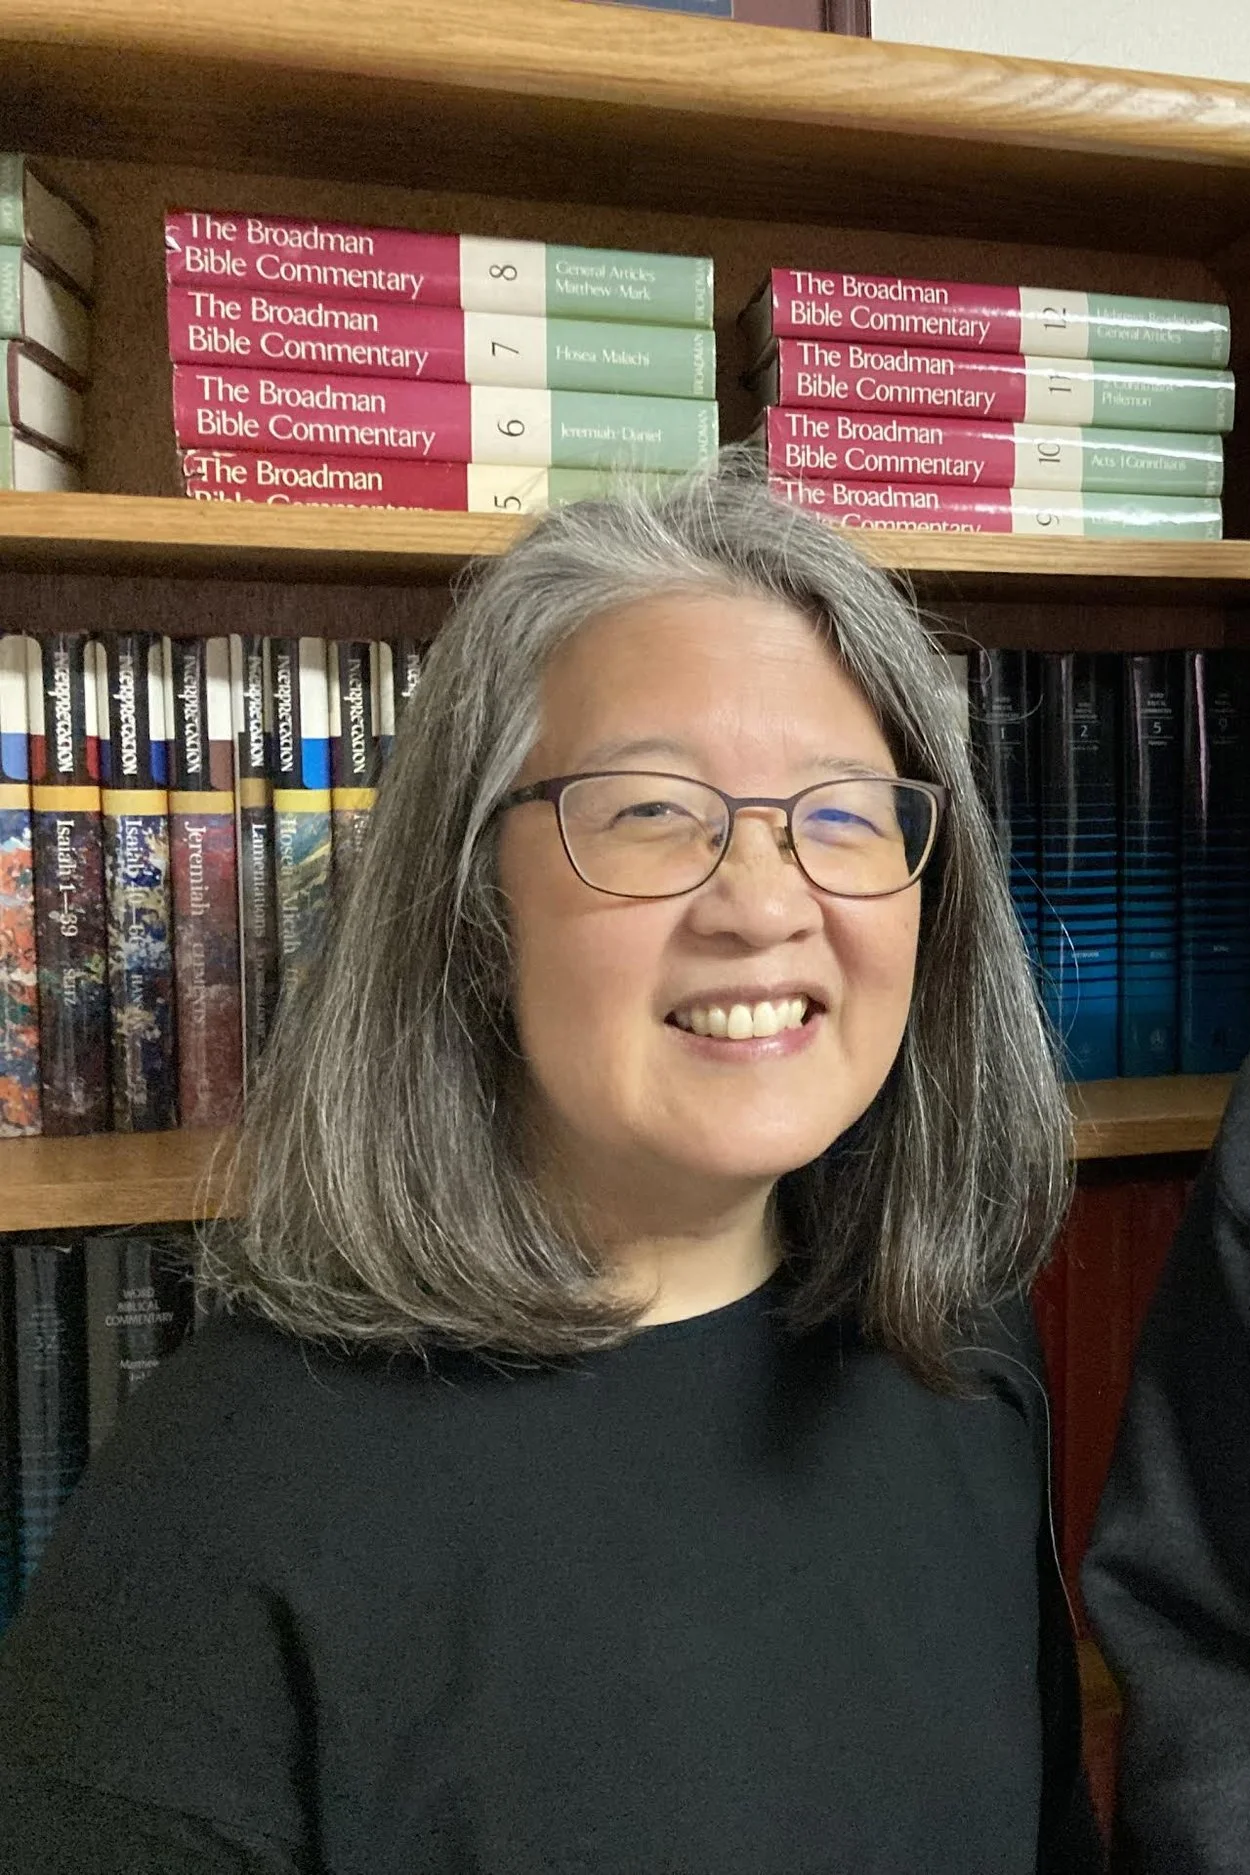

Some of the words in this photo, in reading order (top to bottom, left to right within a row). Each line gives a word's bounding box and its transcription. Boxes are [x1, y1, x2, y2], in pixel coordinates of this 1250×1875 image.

[185, 213, 237, 241] The
[247, 218, 374, 256] Broadman
[185, 246, 248, 276] Bible
[256, 254, 424, 299] Commentary
[489, 263, 518, 282] 8
[790, 270, 835, 296] The
[842, 275, 948, 305] Broadman
[188, 291, 241, 320] The
[251, 296, 379, 332] Broadman
[790, 299, 843, 327] Bible
[849, 305, 991, 344] Commentary
[188, 325, 251, 355] Bible
[260, 332, 429, 375] Commentary
[491, 341, 520, 357] 7
[797, 343, 842, 368] The
[849, 346, 954, 376] Broadman
[196, 375, 250, 404] The
[259, 379, 386, 413] Broadman
[797, 373, 849, 399] Bible
[856, 377, 996, 414] Commentary
[197, 408, 260, 438] Bible
[269, 414, 436, 455] Commentary
[497, 418, 525, 437] 6
[785, 413, 830, 439] The
[837, 416, 943, 445] Broadman
[196, 456, 248, 484] The
[257, 460, 383, 491] Broadman
[785, 443, 838, 470] Bible
[845, 448, 985, 483] Commentary
[781, 480, 825, 505] The
[832, 483, 939, 510] Broadman
[184, 822, 210, 916] Jeremiah
